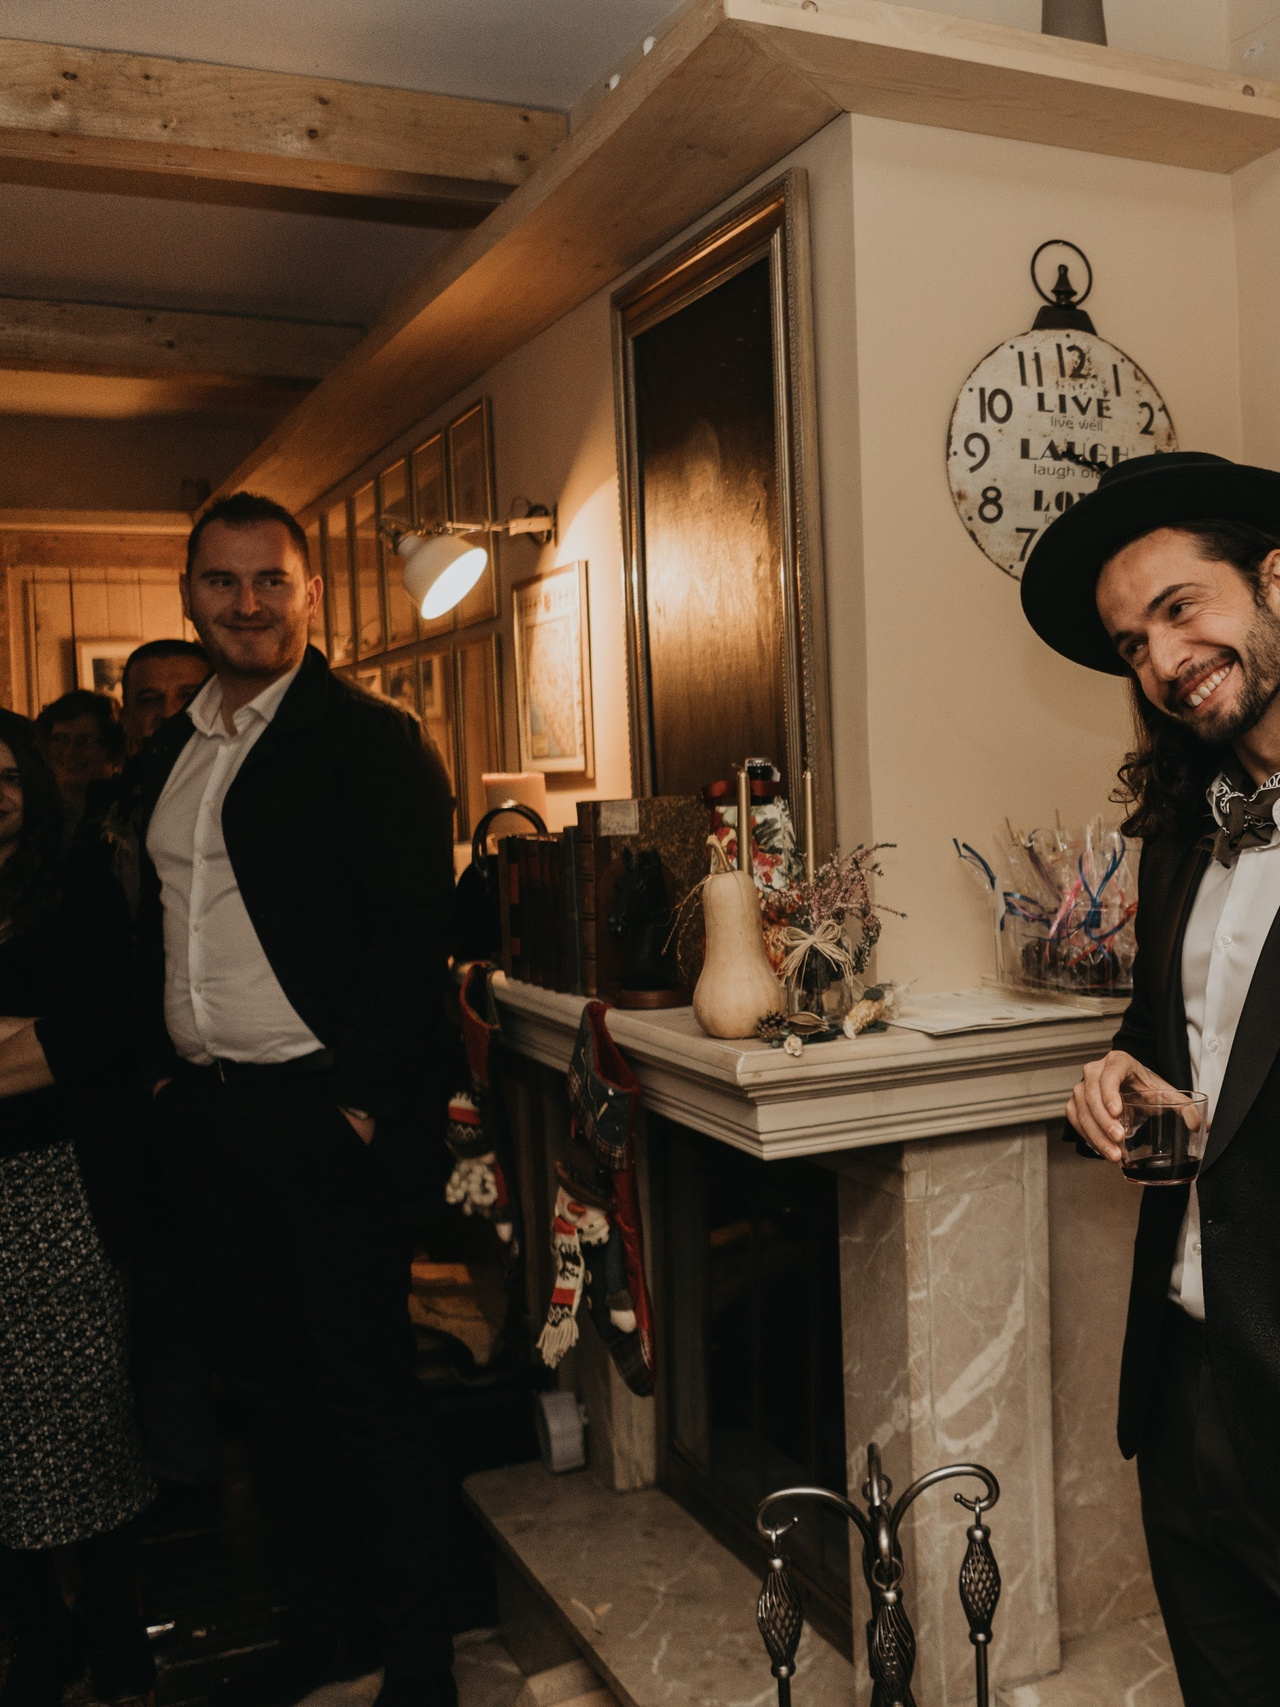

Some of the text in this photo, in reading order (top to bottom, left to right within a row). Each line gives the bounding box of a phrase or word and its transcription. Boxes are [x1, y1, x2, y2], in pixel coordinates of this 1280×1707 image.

[1018, 351, 1043, 387] 11
[1056, 343, 1090, 379] 12
[979, 387, 1013, 424] 10
[1037, 392, 1113, 419] LIVE
[1137, 401, 1155, 435] 2
[1050, 416, 1103, 432] live well
[963, 432, 990, 473] 9
[1020, 438, 1129, 465] LAUGH
[1033, 463, 1075, 480] laugh
[978, 486, 1003, 524] 8
[1033, 490, 1086, 512] LO
[1015, 527, 1039, 562] 7
